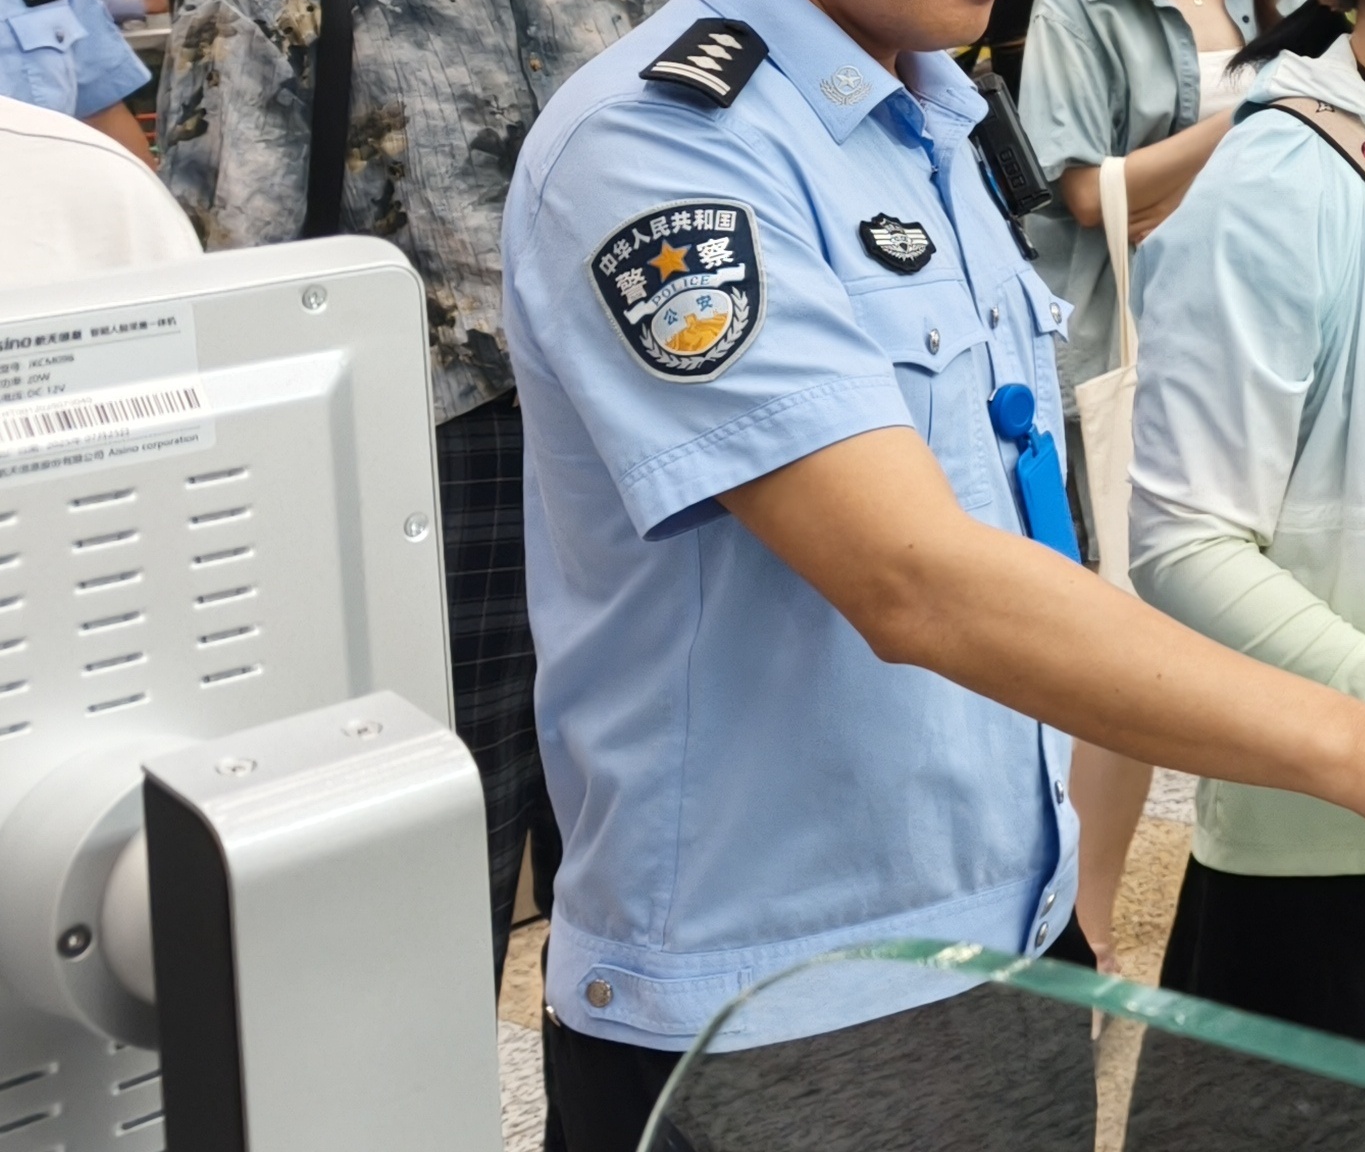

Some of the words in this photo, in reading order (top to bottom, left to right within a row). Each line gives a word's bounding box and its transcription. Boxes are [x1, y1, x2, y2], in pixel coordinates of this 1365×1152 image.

[599, 209, 737, 277] 中华人民共和国
[652, 274, 711, 307] POLICE
[141, 433, 199, 452] corporation
